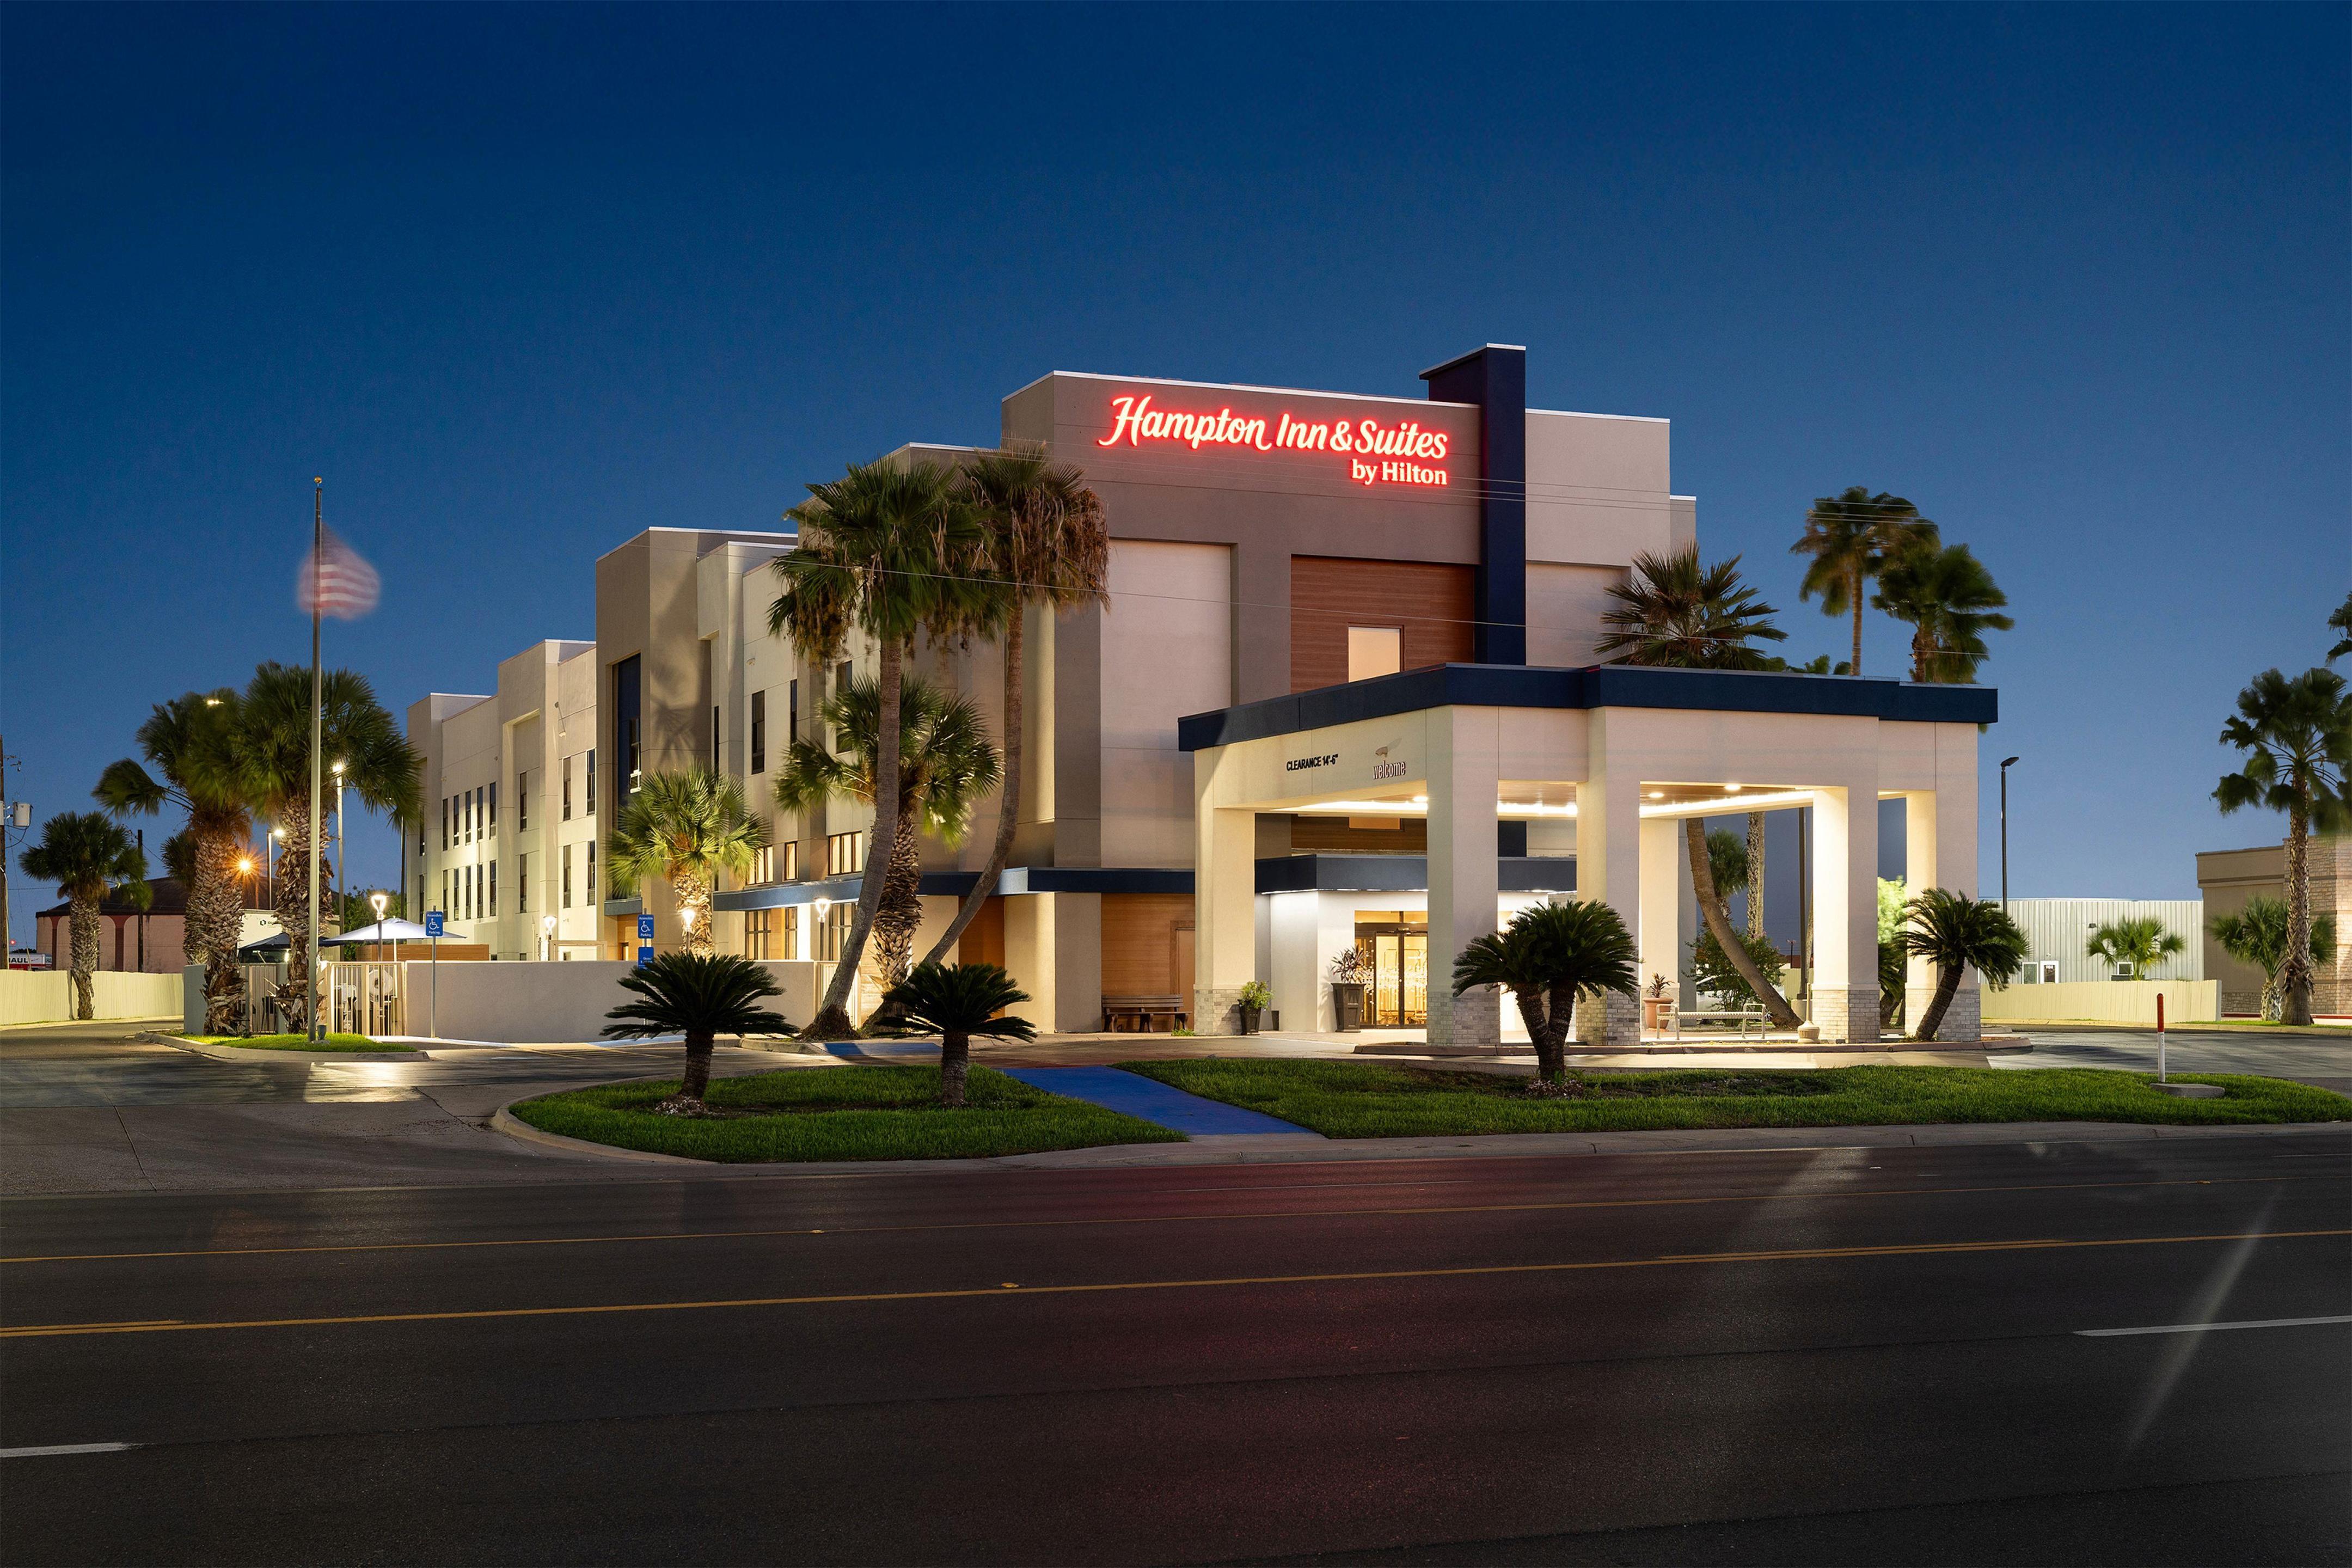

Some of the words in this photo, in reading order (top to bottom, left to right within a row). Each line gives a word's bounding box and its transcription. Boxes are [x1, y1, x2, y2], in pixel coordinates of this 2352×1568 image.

[1098, 395, 1272, 451] Hampton
[1351, 458, 1378, 485] by
[1381, 461, 1448, 485] Hilton
[1287, 756, 1321, 771] CLEARANCE
[1372, 760, 1406, 780] welcome
